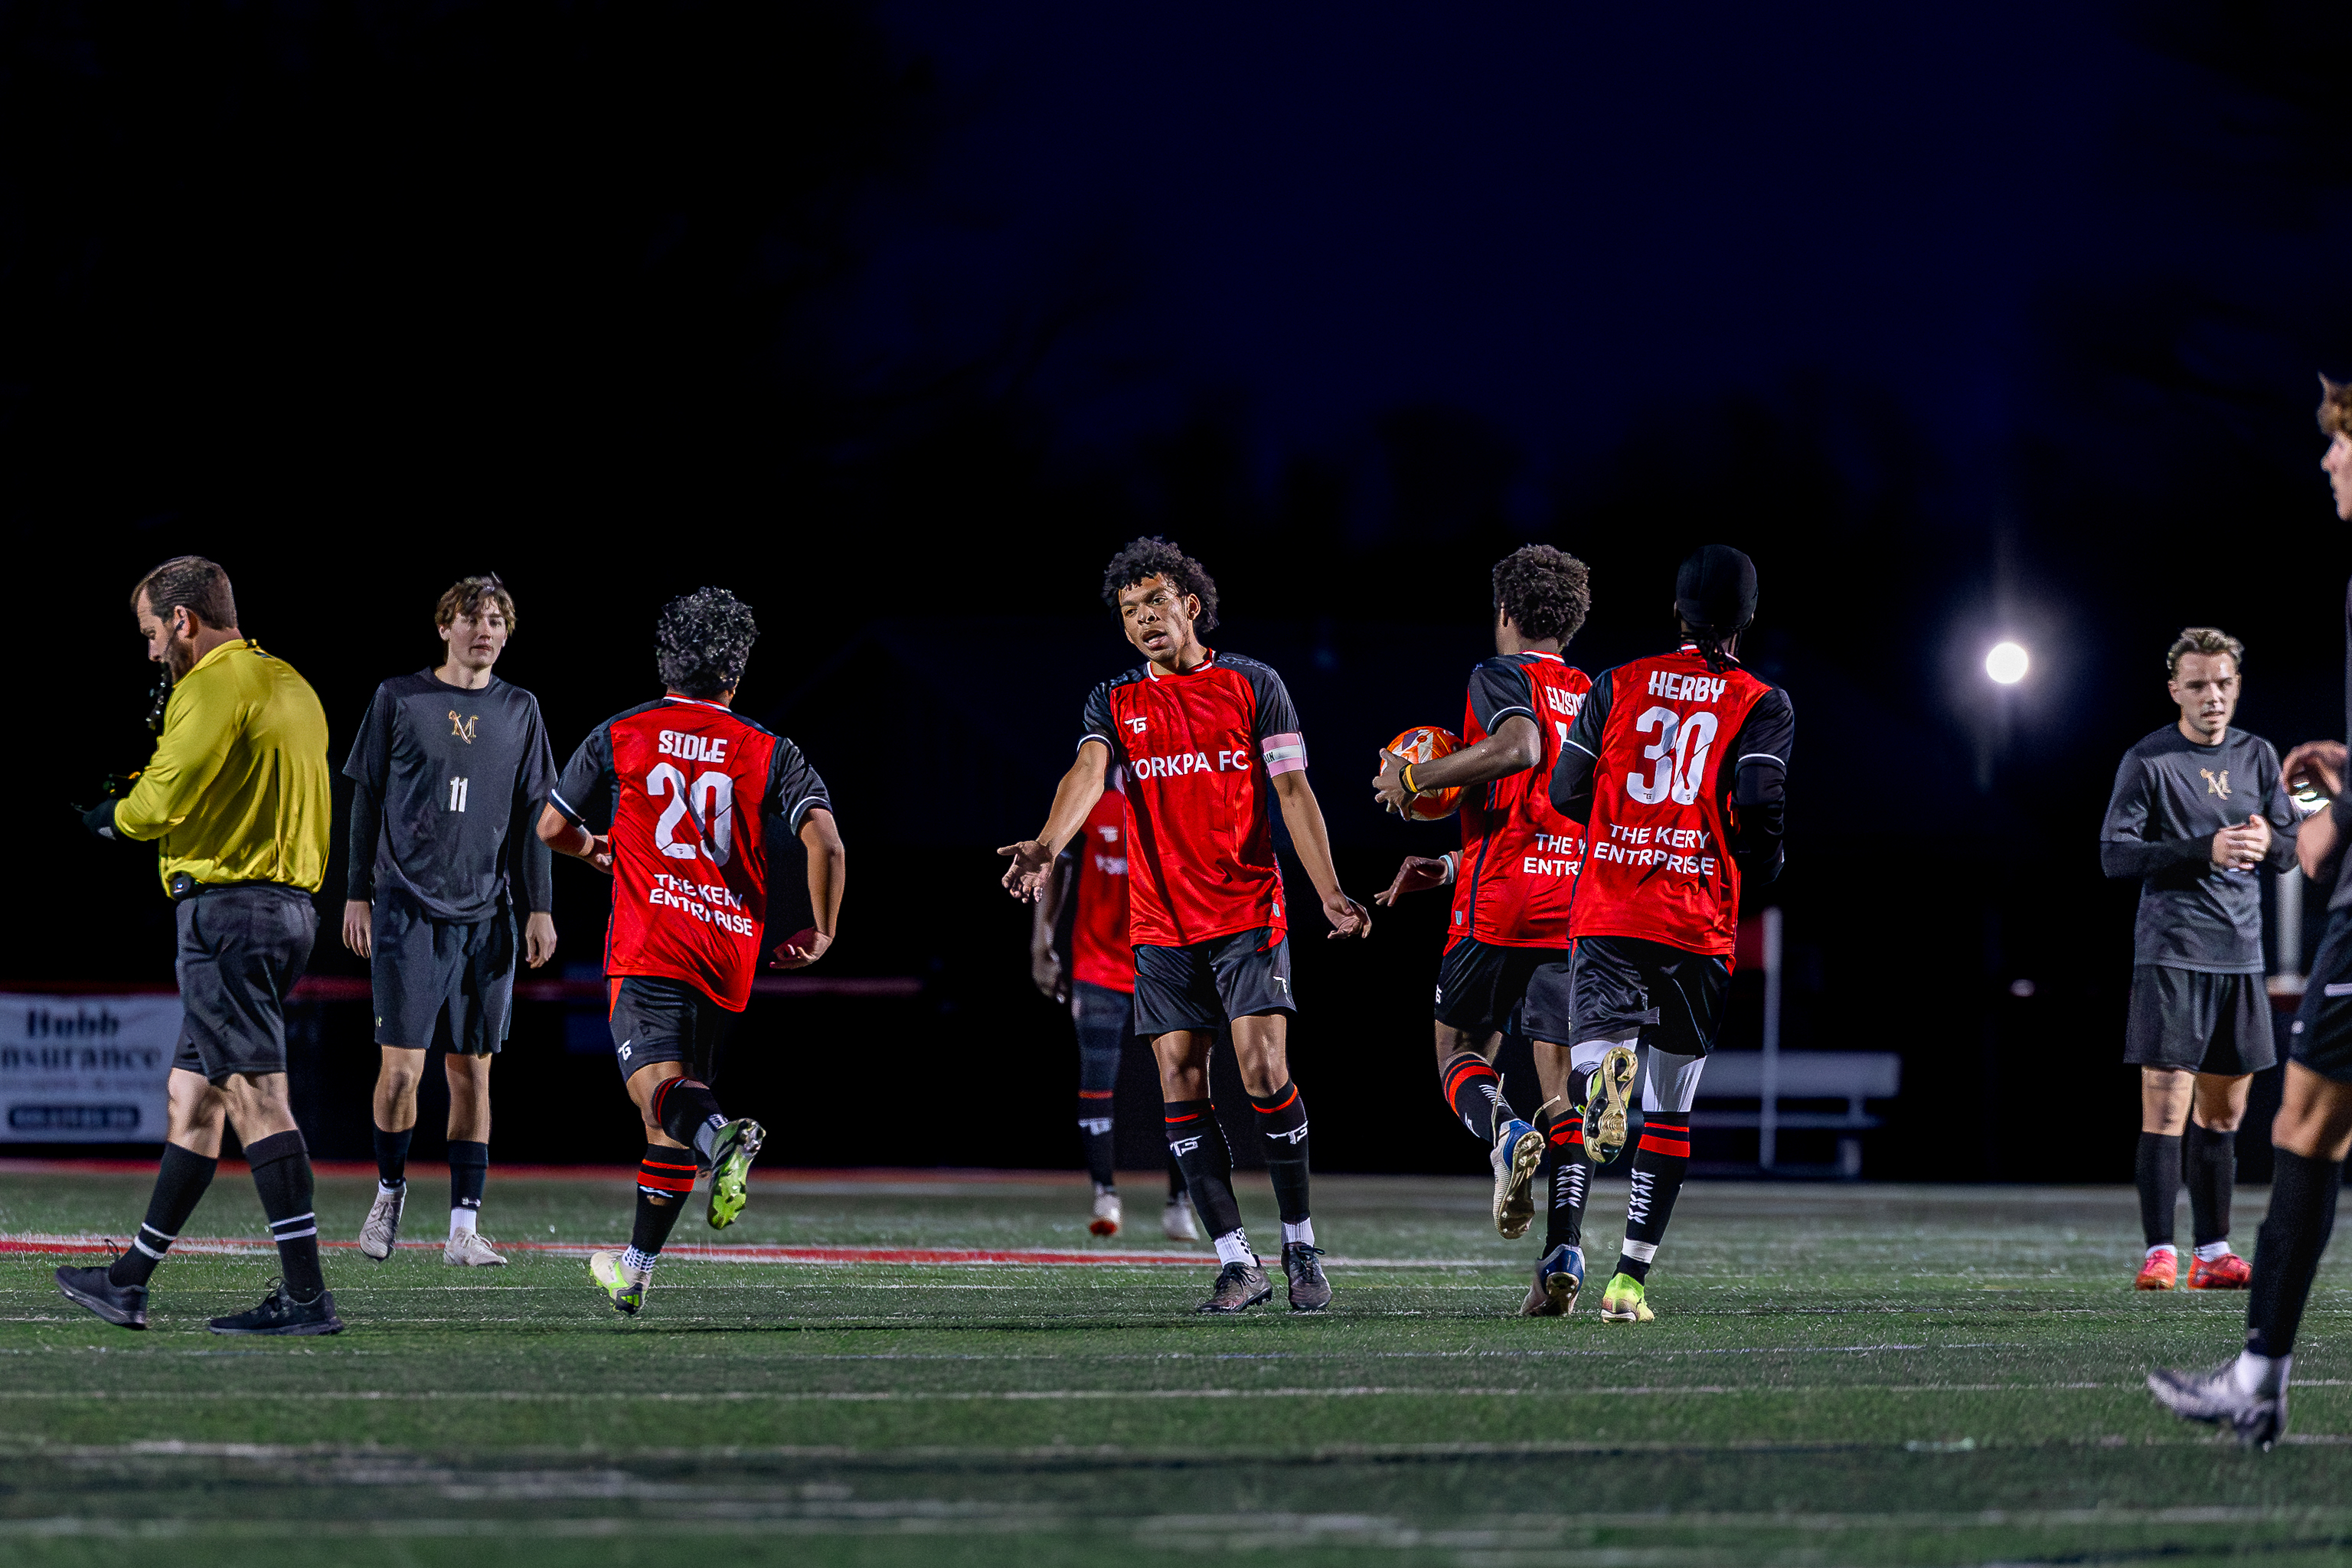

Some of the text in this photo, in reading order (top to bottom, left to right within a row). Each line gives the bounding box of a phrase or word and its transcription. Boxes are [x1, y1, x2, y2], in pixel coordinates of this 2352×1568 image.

[1648, 671, 1727, 703] HERBY
[658, 730, 727, 763] SIDLE
[1218, 750, 1250, 771] FC
[1626, 706, 1718, 805] 30
[449, 776, 469, 813] 11
[646, 762, 733, 867] 20
[1535, 833, 1573, 854] THE
[1610, 823, 1710, 849] THE KERY
[1594, 841, 1715, 876] ENTRPRISE
[654, 874, 697, 897] THE
[0, 1044, 161, 1070] nsurance
